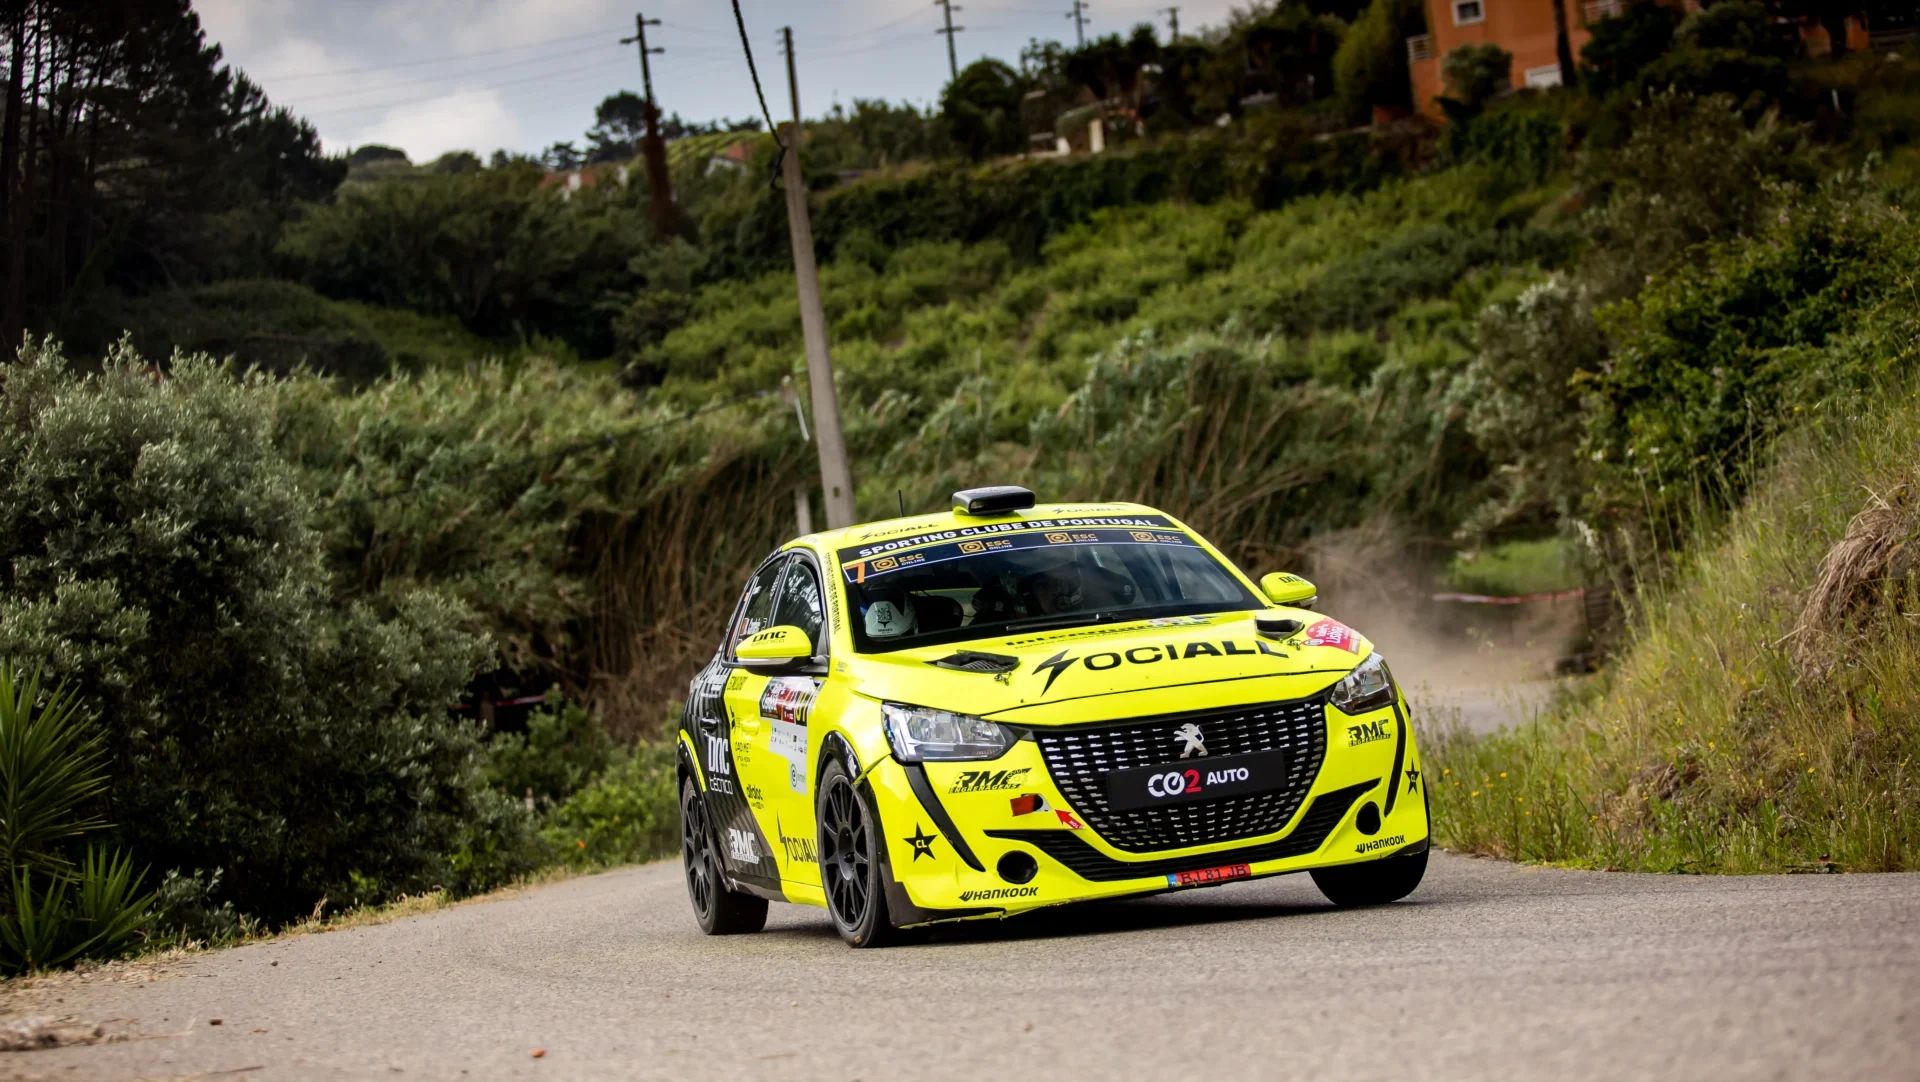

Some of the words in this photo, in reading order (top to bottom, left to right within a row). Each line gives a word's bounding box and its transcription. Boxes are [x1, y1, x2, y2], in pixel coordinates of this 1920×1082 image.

[858, 530, 957, 557] SPORTING
[960, 521, 1025, 537] CLUBE
[1027, 519, 1054, 529] DE
[1056, 518, 1159, 527] PORTUGAL
[986, 539, 1011, 548] ESC
[898, 553, 924, 563] ESC
[901, 558, 926, 566] ONLINE
[844, 561, 865, 584] 7
[1147, 769, 1202, 797] CO2
[1206, 767, 1249, 786] AUTO
[948, 784, 1022, 794] ENGRENAGENS
[915, 839, 928, 849] CL
[1181, 872, 1200, 884] BJ
[1205, 868, 1222, 880] 81
[1228, 865, 1247, 878] JB
